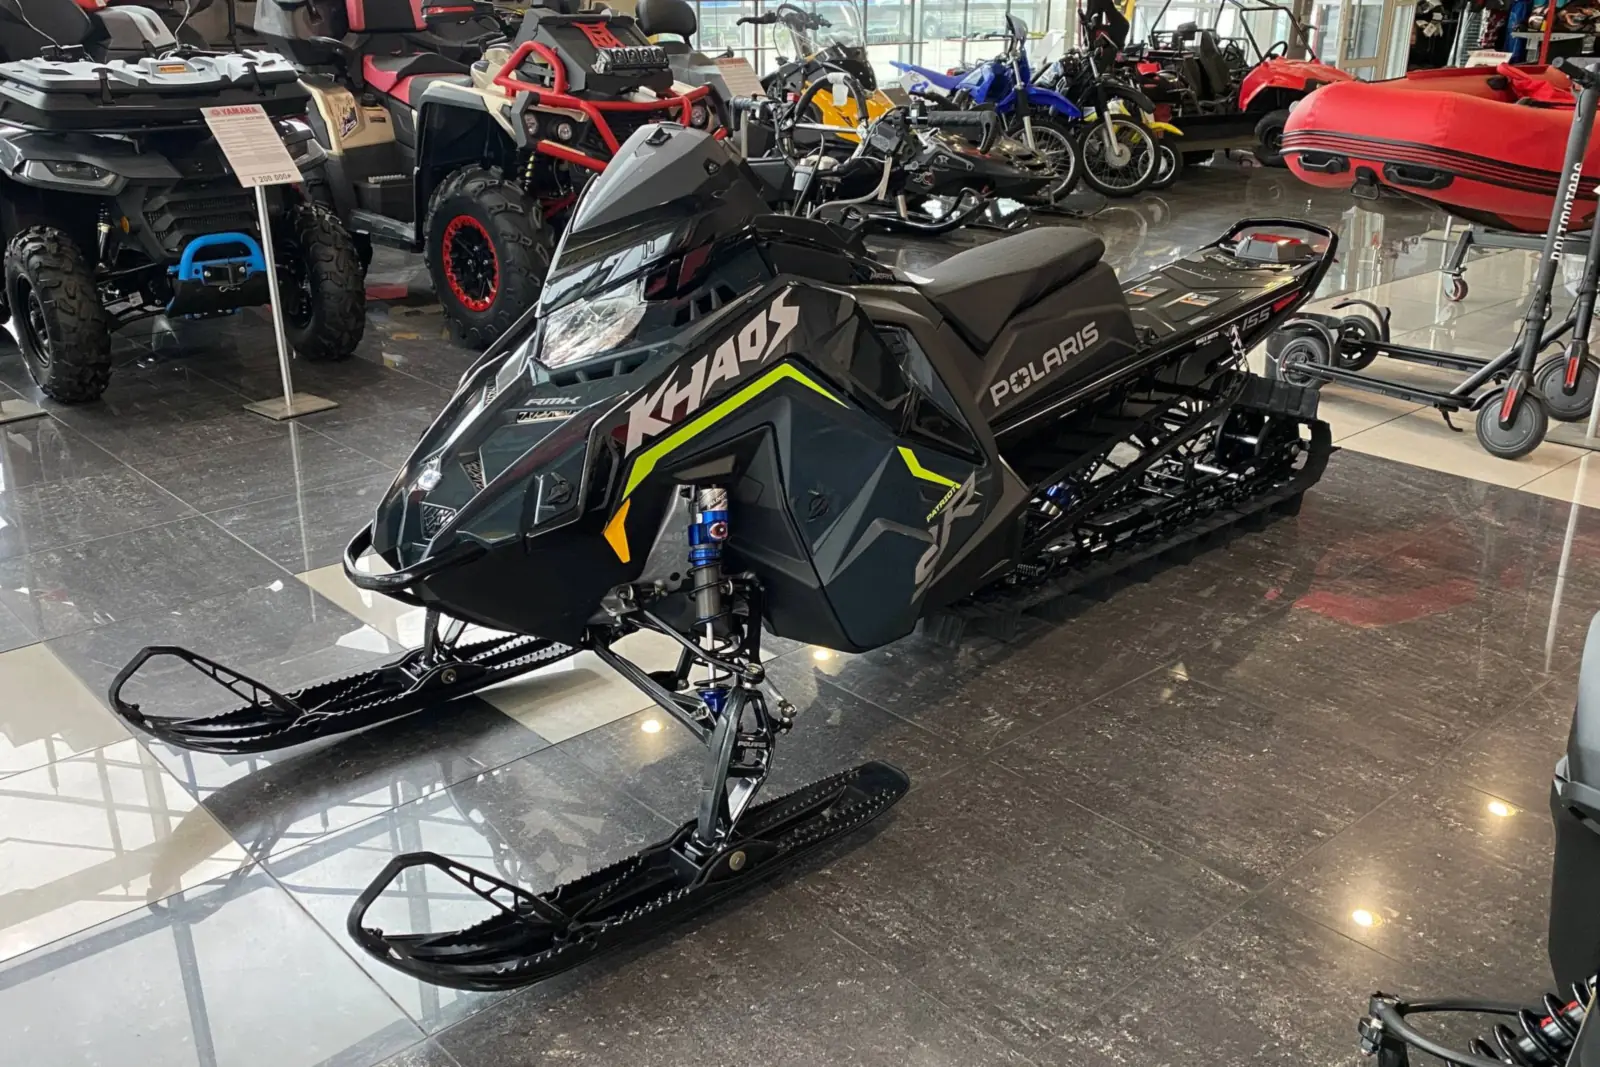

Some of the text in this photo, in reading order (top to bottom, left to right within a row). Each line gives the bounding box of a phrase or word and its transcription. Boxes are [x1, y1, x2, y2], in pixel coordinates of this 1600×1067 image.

[221, 106, 258, 116] YAMAHA
[259, 174, 273, 183] 200
[1241, 306, 1271, 332] 155
[624, 285, 800, 459] KHAOS
[989, 320, 1100, 407] POLARIS
[523, 396, 582, 407] RMK
[925, 483, 957, 524] PATRIOT
